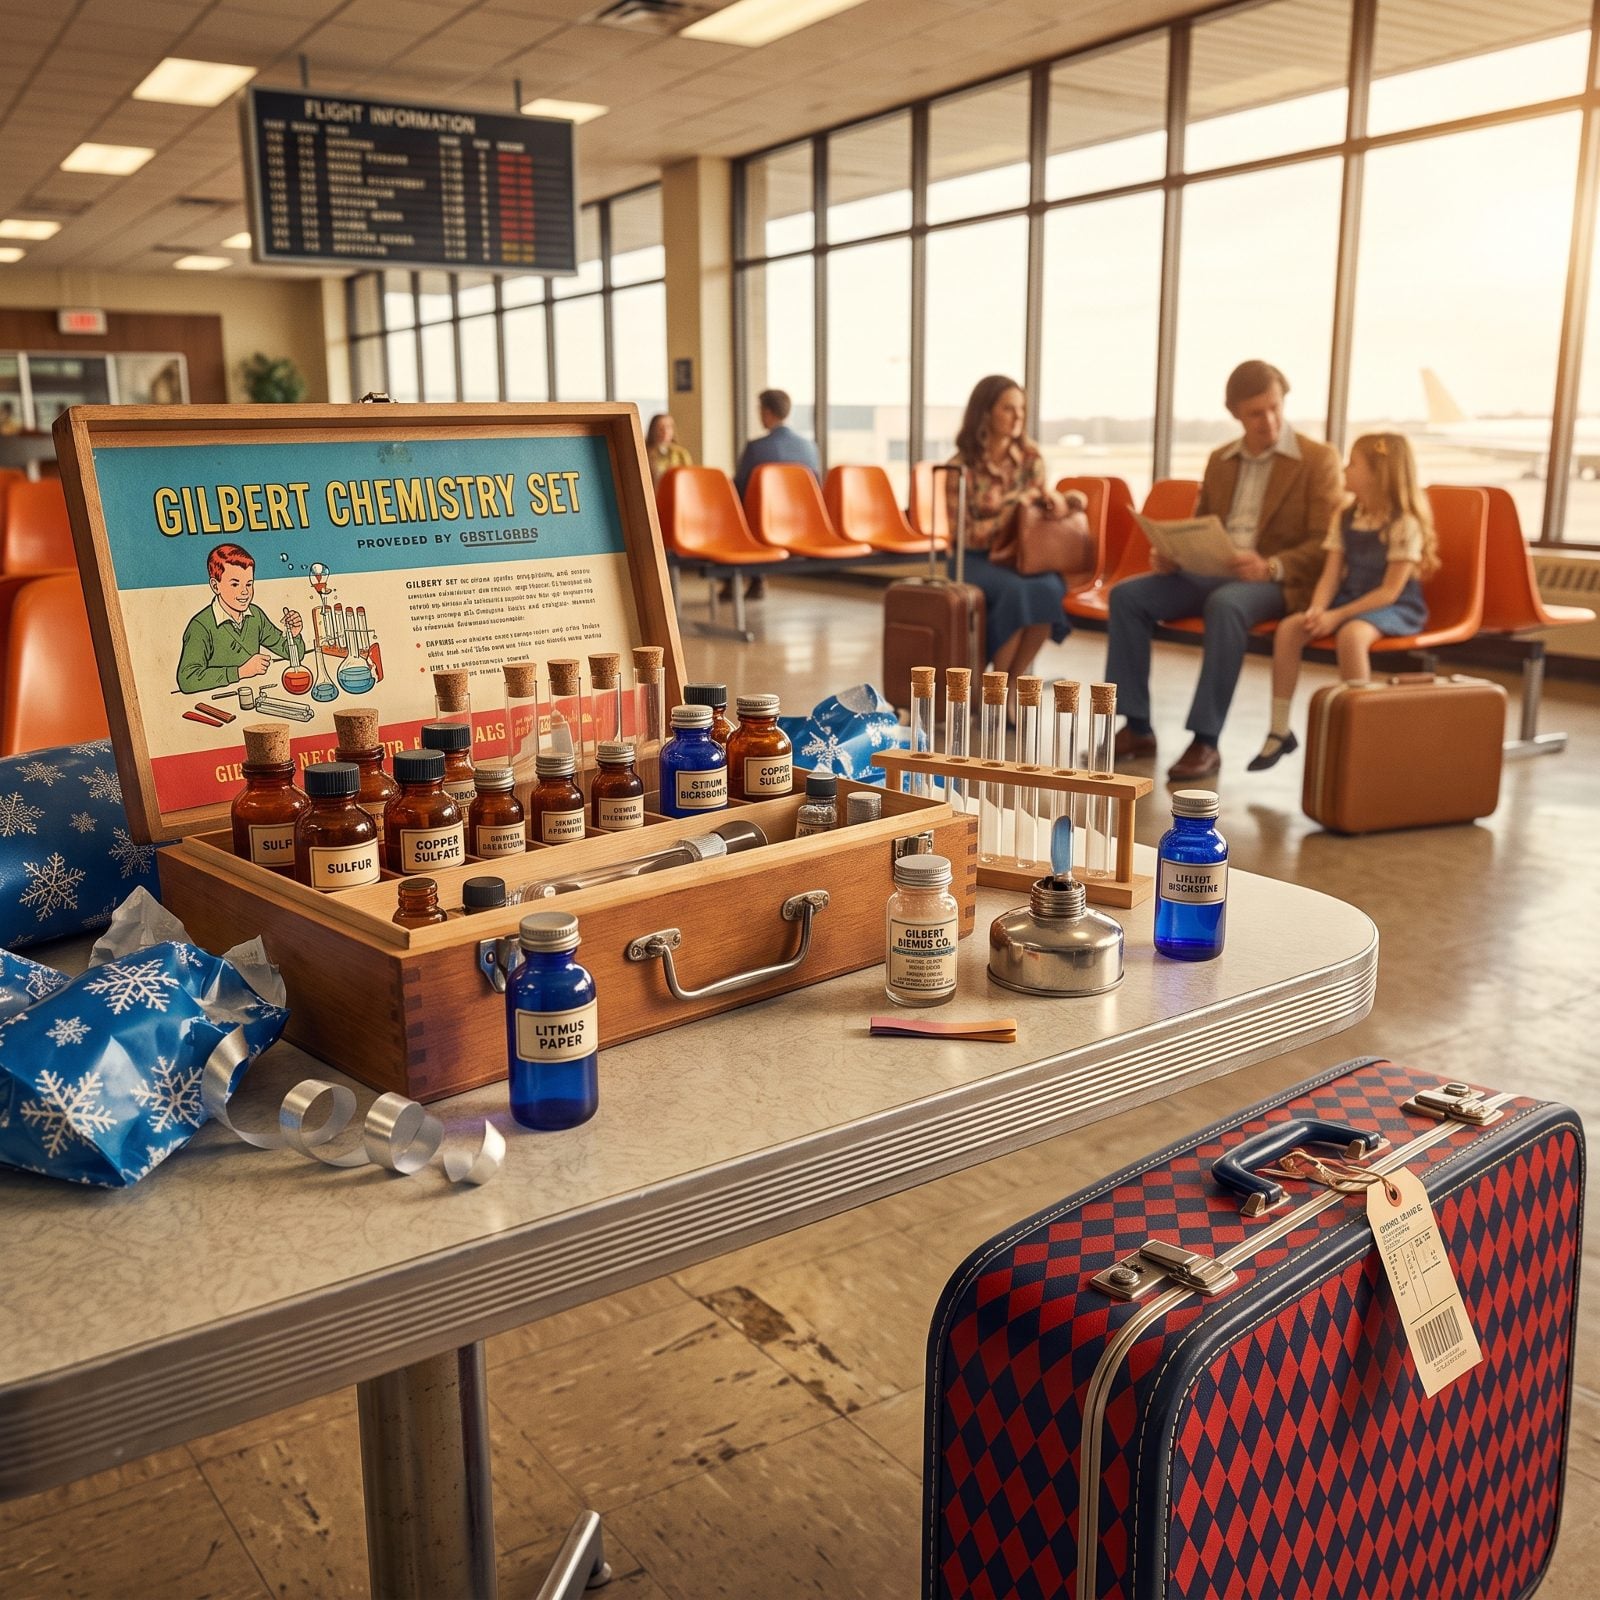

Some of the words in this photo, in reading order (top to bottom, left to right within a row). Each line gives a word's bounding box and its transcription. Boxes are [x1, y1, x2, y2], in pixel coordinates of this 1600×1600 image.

[304, 99, 363, 123] FLIGHT
[369, 107, 476, 134] INFORMATION
[153, 482, 311, 537] GILBERT
[326, 473, 517, 528] CHEMISTRY
[526, 471, 582, 517] SET
[357, 535, 428, 549] PROVEDED
[435, 533, 452, 544] BY
[405, 578, 443, 589] GILBERY
[445, 578, 458, 586] SET
[416, 835, 459, 850] COPPER
[414, 846, 460, 863] SULFATE
[327, 858, 372, 874] SULFUR
[905, 928, 945, 939] GILBERT
[536, 1020, 585, 1036] LITMUS
[539, 1034, 582, 1050] PAPER
